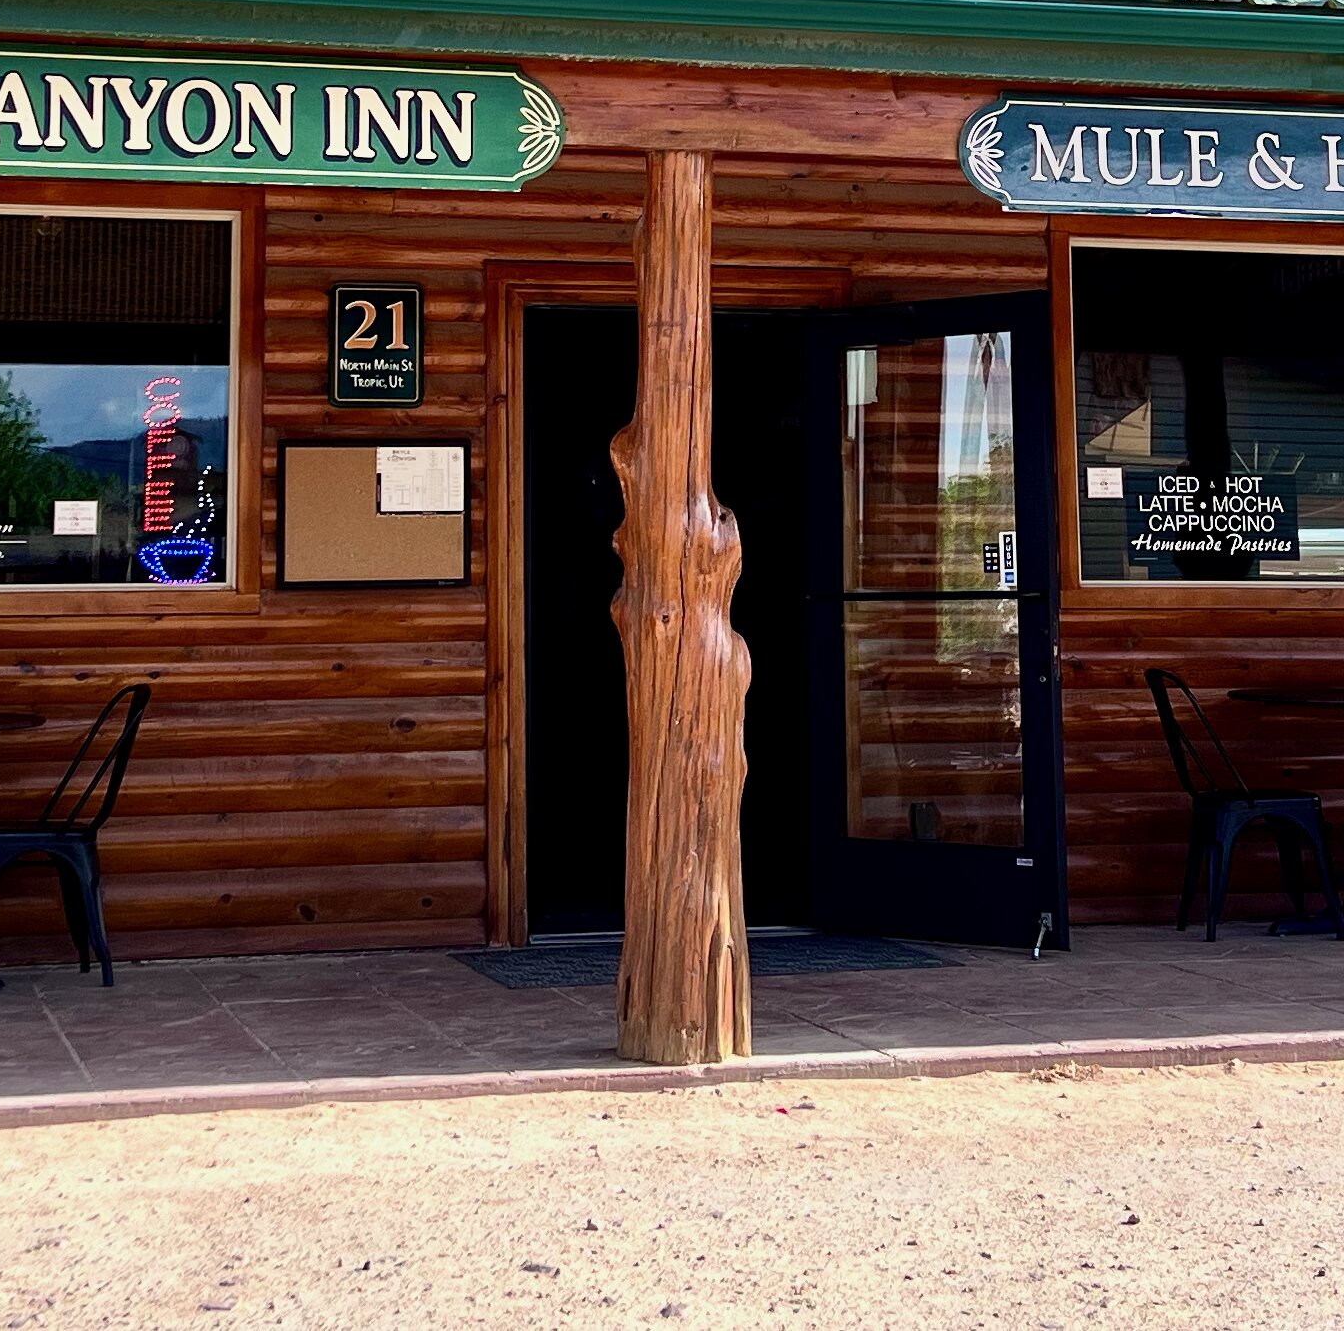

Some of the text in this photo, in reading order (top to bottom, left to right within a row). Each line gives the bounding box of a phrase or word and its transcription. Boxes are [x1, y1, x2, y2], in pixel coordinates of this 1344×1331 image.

[323, 85, 477, 167] INN
[1027, 123, 1224, 188] MULE
[1248, 132, 1304, 191] &
[344, 300, 410, 350] 21
[143, 376, 181, 531] COFFEE
[1158, 476, 1263, 494] ICED & HOT
[1138, 495, 1284, 513] LATTE MOCHA
[1148, 515, 1275, 532] CAPPUCCINO
[1130, 533, 1292, 555] Homemade Pastries
